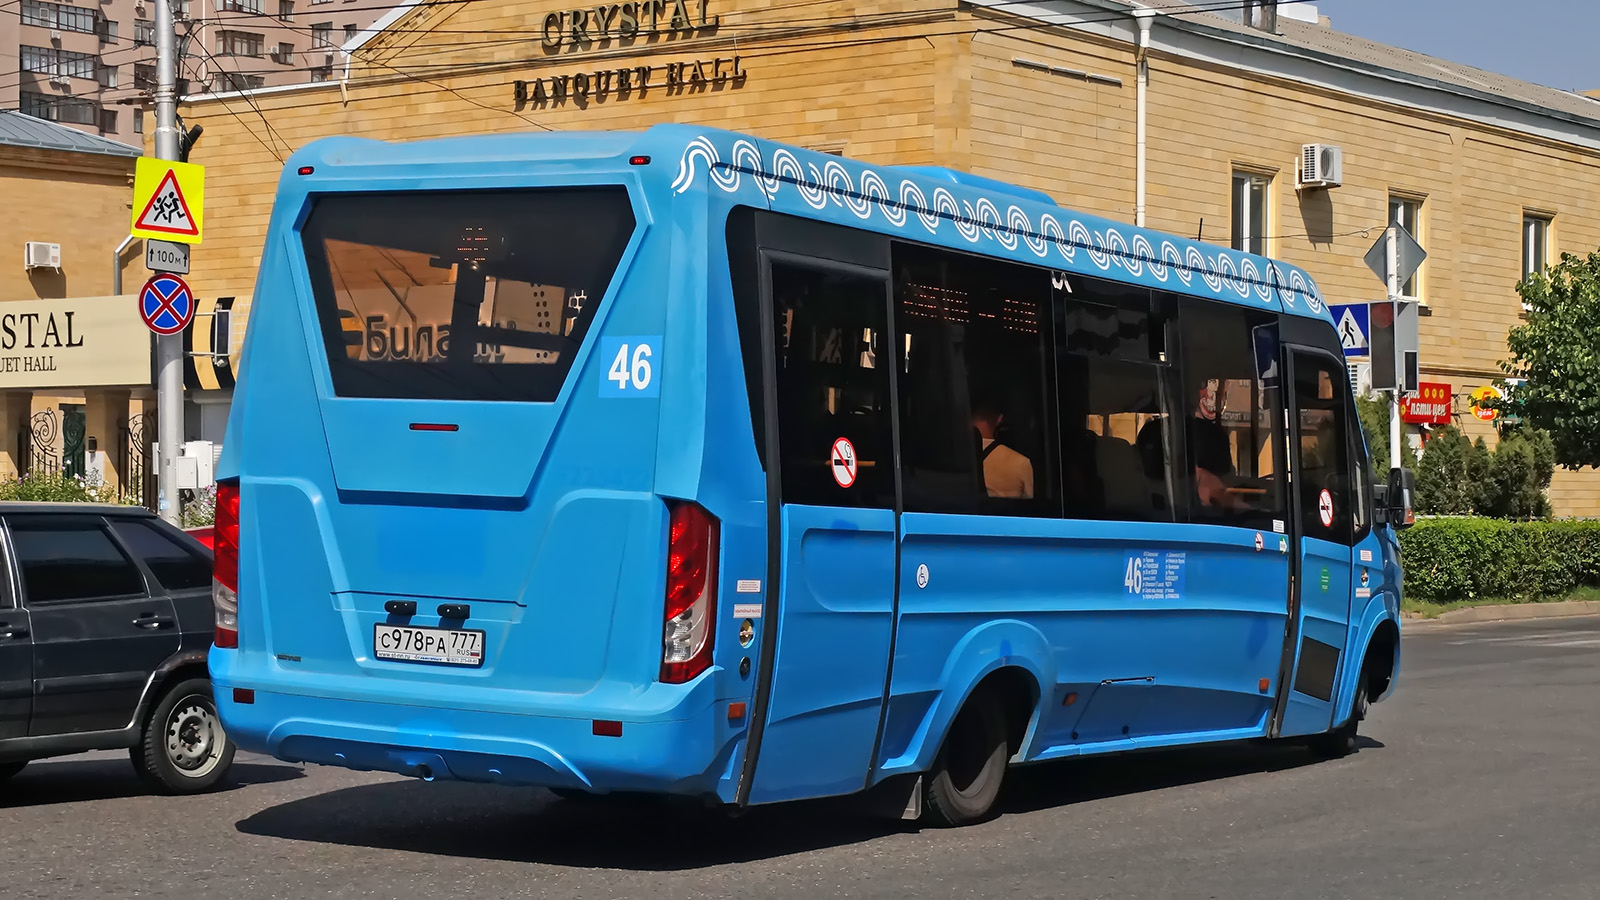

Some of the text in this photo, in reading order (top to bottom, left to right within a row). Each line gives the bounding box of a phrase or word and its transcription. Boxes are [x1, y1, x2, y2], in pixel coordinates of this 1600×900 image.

[541, 0, 719, 47] CRYSTAL
[513, 56, 747, 101] BANQUET HALL
[1, 311, 84, 350] STAL
[24, 355, 57, 372] HALL
[607, 343, 653, 390] 46
[1124, 556, 1142, 594] 46
[451, 632, 477, 649] 777
